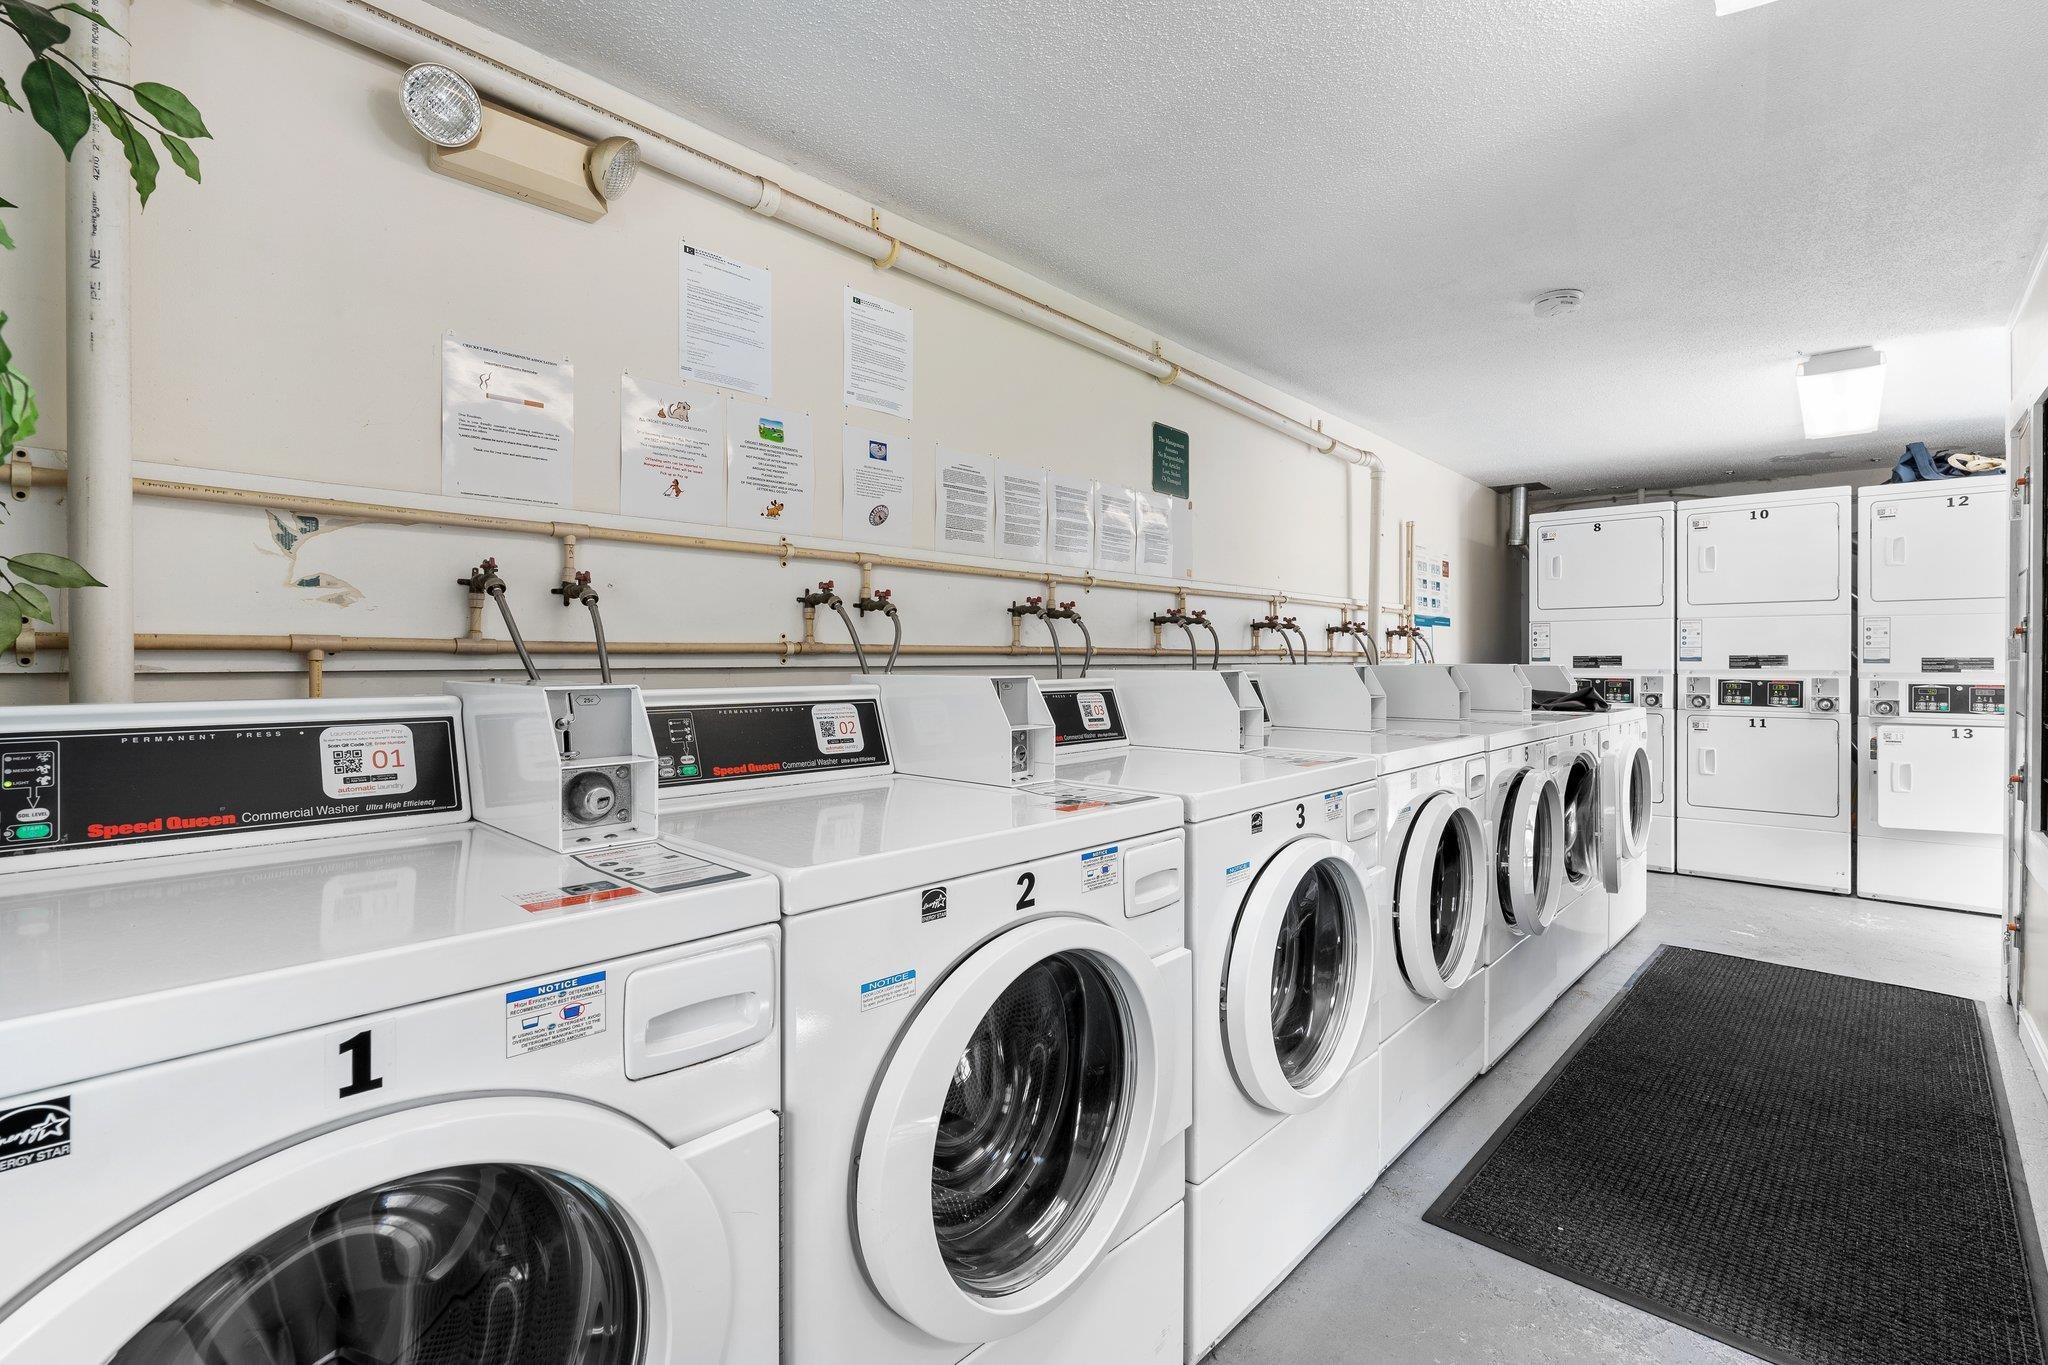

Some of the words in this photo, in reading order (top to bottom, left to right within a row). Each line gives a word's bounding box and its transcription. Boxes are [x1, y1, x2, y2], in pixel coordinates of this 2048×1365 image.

[1946, 496, 1969, 507] 12
[1750, 510, 1769, 520] 10
[1593, 523, 1601, 532] 8
[1094, 705, 1105, 716] 03
[840, 721, 856, 734] 02
[1749, 718, 1766, 728] 11
[121, 734, 216, 743] PERMANENT
[236, 731, 282, 739] PRESS
[1951, 728, 1973, 739] 13
[372, 749, 405, 769] 01
[1524, 746, 1529, 762] 5
[713, 764, 746, 777] Speed
[748, 762, 780, 773] Queen
[782, 759, 816, 770] Commercial
[817, 758, 838, 766] Washer
[1435, 766, 1441, 784] 4
[337, 785, 376, 793] automatic
[87, 818, 163, 839] Speed
[166, 812, 236, 830] Queen
[242, 806, 314, 823] Commercial
[315, 803, 359, 818] Washer
[365, 803, 383, 812] Ultra
[384, 801, 401, 811] High
[403, 798, 436, 809] Efficiency
[1296, 804, 1305, 828] 3
[1016, 872, 1035, 911] 2
[538, 979, 578, 994] NOTICE
[869, 973, 909, 990] NOTICE
[510, 1004, 546, 1016] RECOMMENDED
[570, 989, 603, 1001] PERFORMANCE
[528, 995, 556, 1006] EFFICIENCY
[568, 986, 593, 995] DETERGENT
[512, 1034, 547, 1046] OVERSUDSING
[556, 1026, 571, 1034] USING
[518, 1030, 533, 1038] USING
[558, 1018, 586, 1028] DETERGENT
[521, 1038, 550, 1048] DETERGENT
[552, 1026, 593, 1039] MANUFACTURERS
[528, 1038, 565, 1052] RECOMMENDED
[339, 1030, 383, 1099] 1
[36, 1145, 70, 1162] STAR
